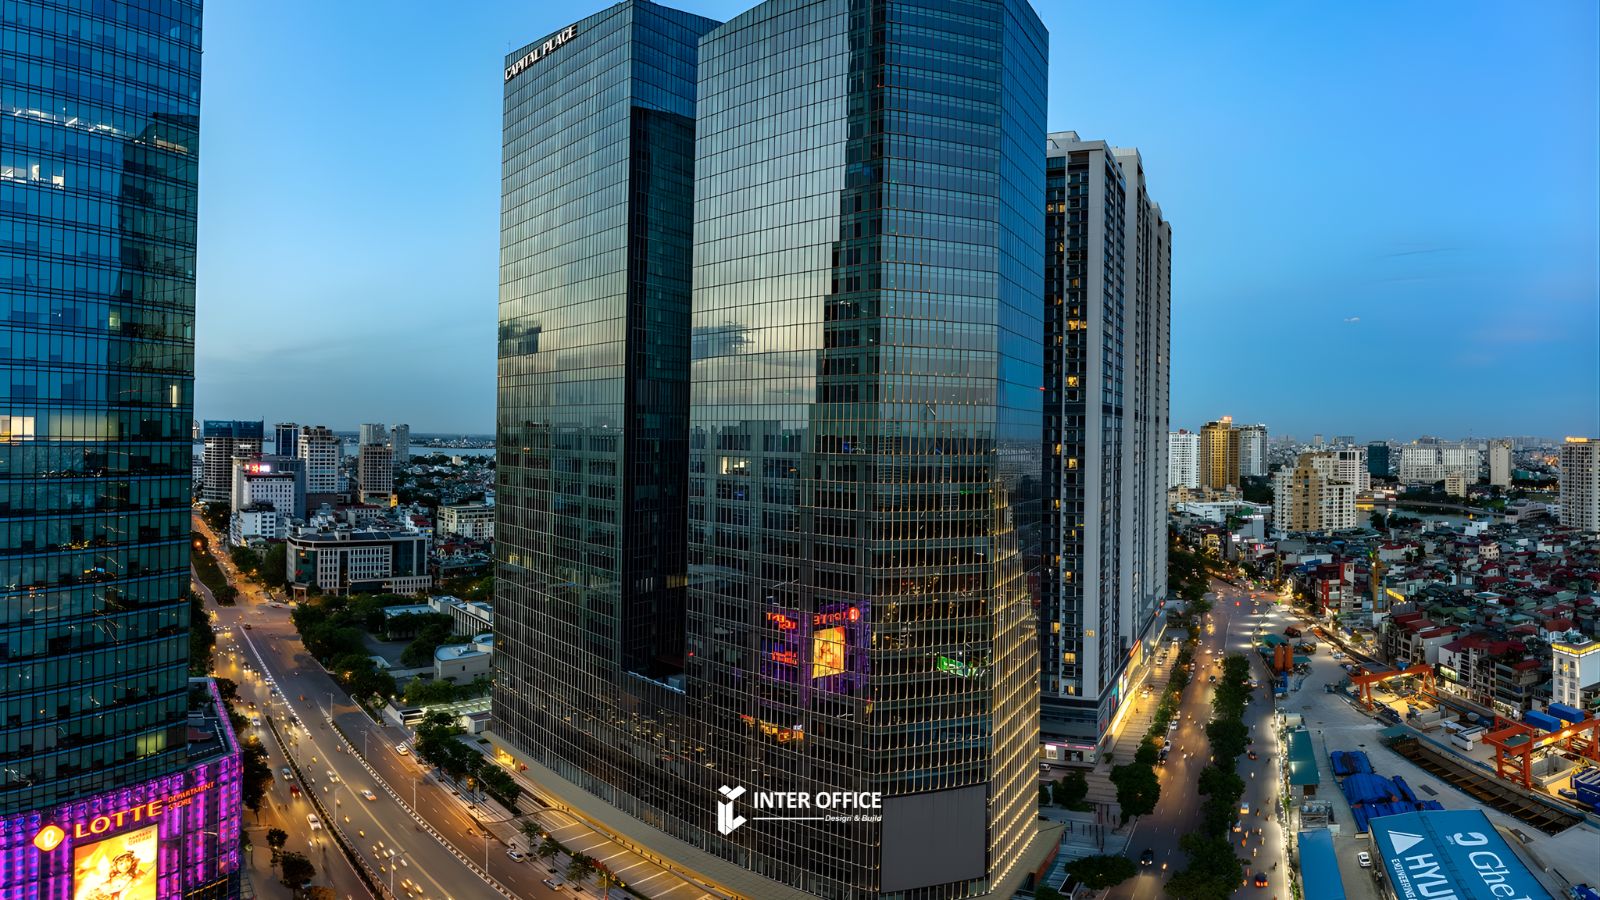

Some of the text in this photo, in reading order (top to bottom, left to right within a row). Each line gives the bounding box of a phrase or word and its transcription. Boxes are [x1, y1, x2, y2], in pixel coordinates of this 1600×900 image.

[505, 24, 577, 80] CAPITAL PLACE
[168, 781, 215, 803] DEPARTMENT
[168, 798, 193, 811] STORE
[75, 799, 163, 838] LOTTE
[1405, 852, 1459, 900] HYU
[1468, 851, 1533, 900] Ghe
